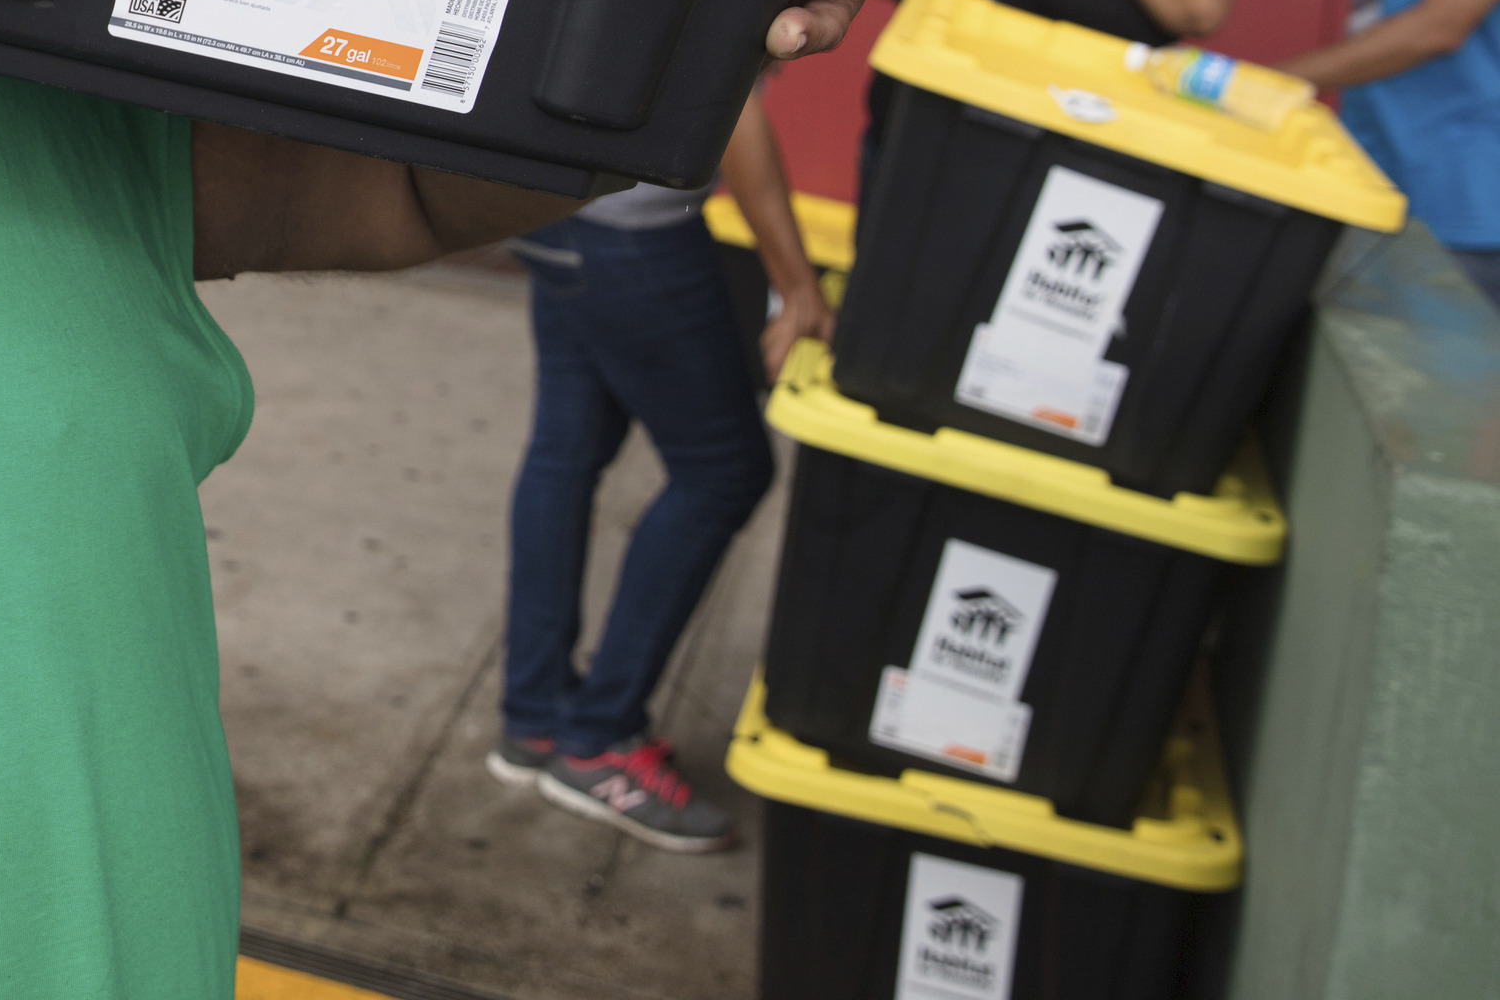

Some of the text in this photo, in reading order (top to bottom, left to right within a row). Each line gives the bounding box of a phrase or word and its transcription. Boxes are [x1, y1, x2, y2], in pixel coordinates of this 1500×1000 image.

[474, 7, 482, 20] HOME
[320, 35, 349, 56] 27
[346, 48, 371, 63] gal
[372, 56, 387, 67] 102
[464, 66, 477, 90] 57150
[473, 39, 486, 63] 00562
